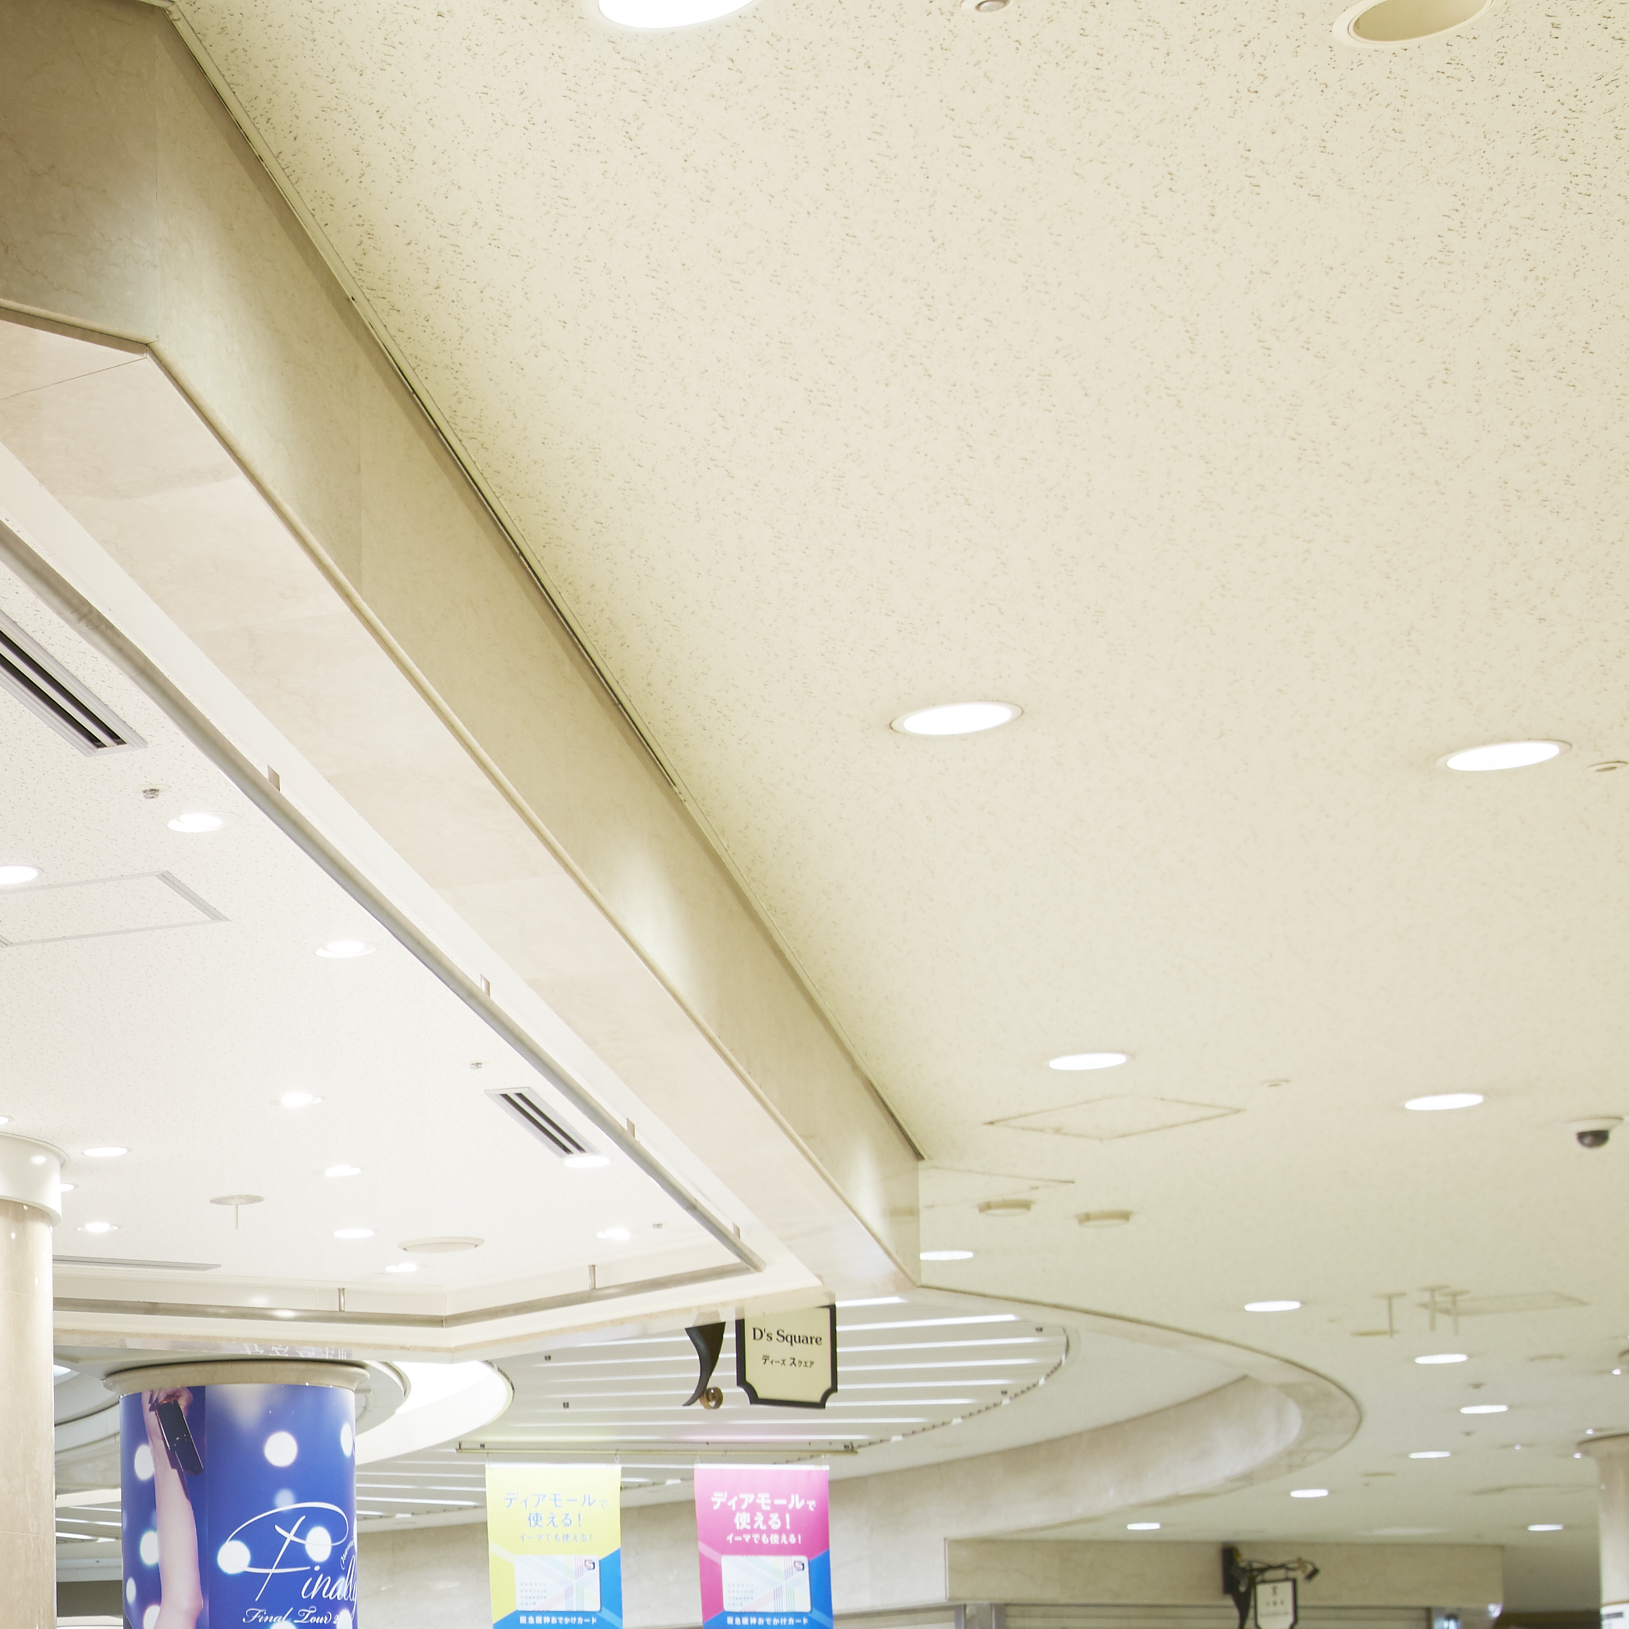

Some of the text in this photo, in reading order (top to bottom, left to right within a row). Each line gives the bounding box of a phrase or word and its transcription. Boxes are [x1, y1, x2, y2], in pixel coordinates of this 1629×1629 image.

[752, 1327, 823, 1346] D's Square
[762, 1354, 815, 1368] ディーズ スクエア
[504, 1492, 608, 1509] ディアモールで
[711, 1491, 816, 1511] ディアモールで
[527, 1512, 583, 1528] 使える！
[734, 1512, 791, 1530] 使える！
